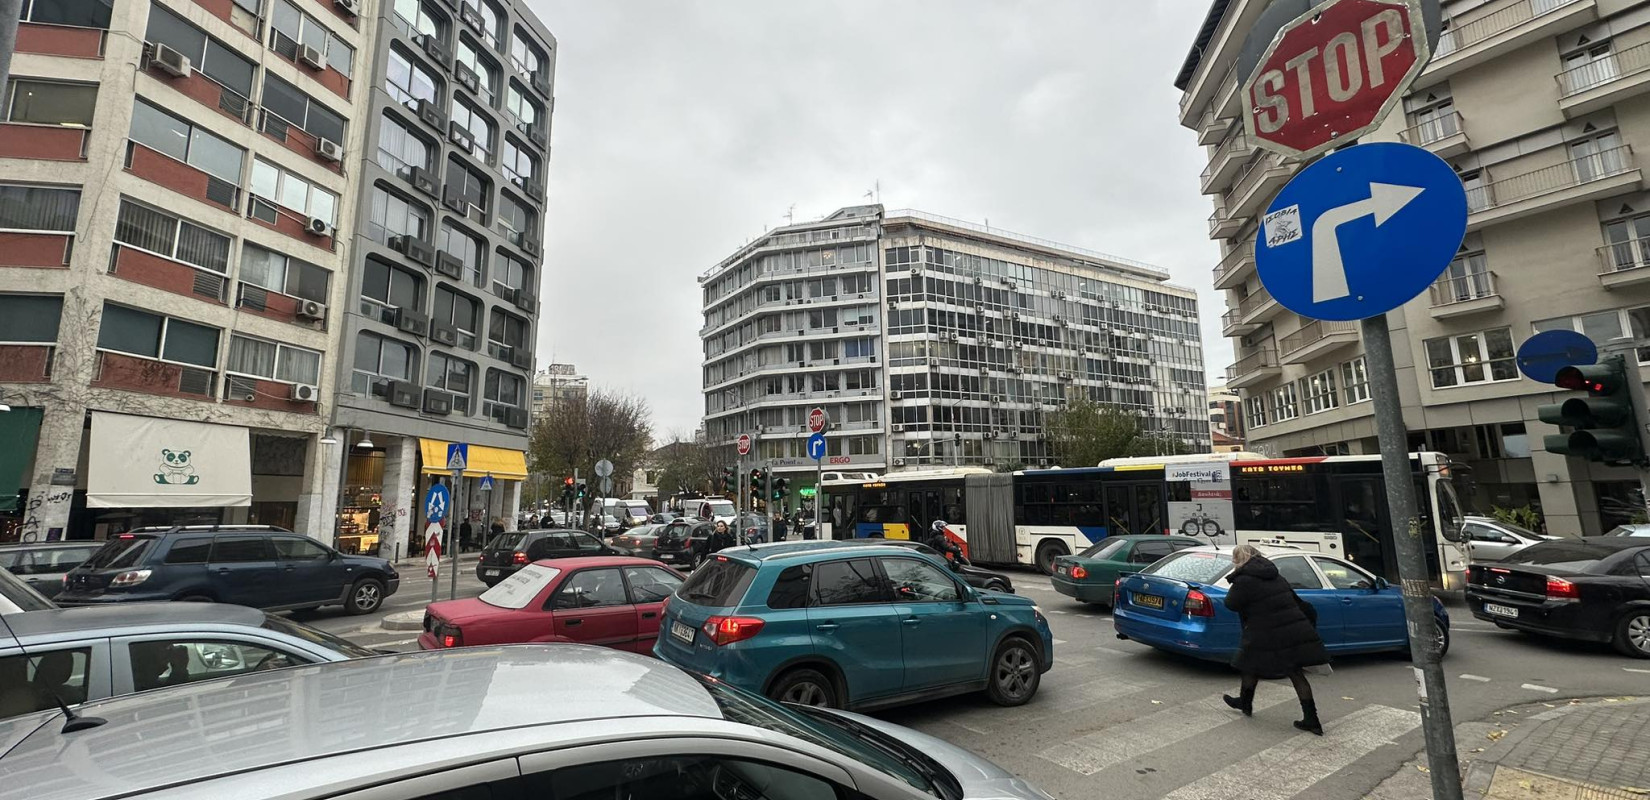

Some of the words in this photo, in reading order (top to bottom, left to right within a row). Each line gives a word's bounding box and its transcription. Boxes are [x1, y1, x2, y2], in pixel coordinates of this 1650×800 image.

[1253, 8, 1404, 134] STOP
[810, 414, 824, 427] STOP
[738, 439, 749, 450] STOP
